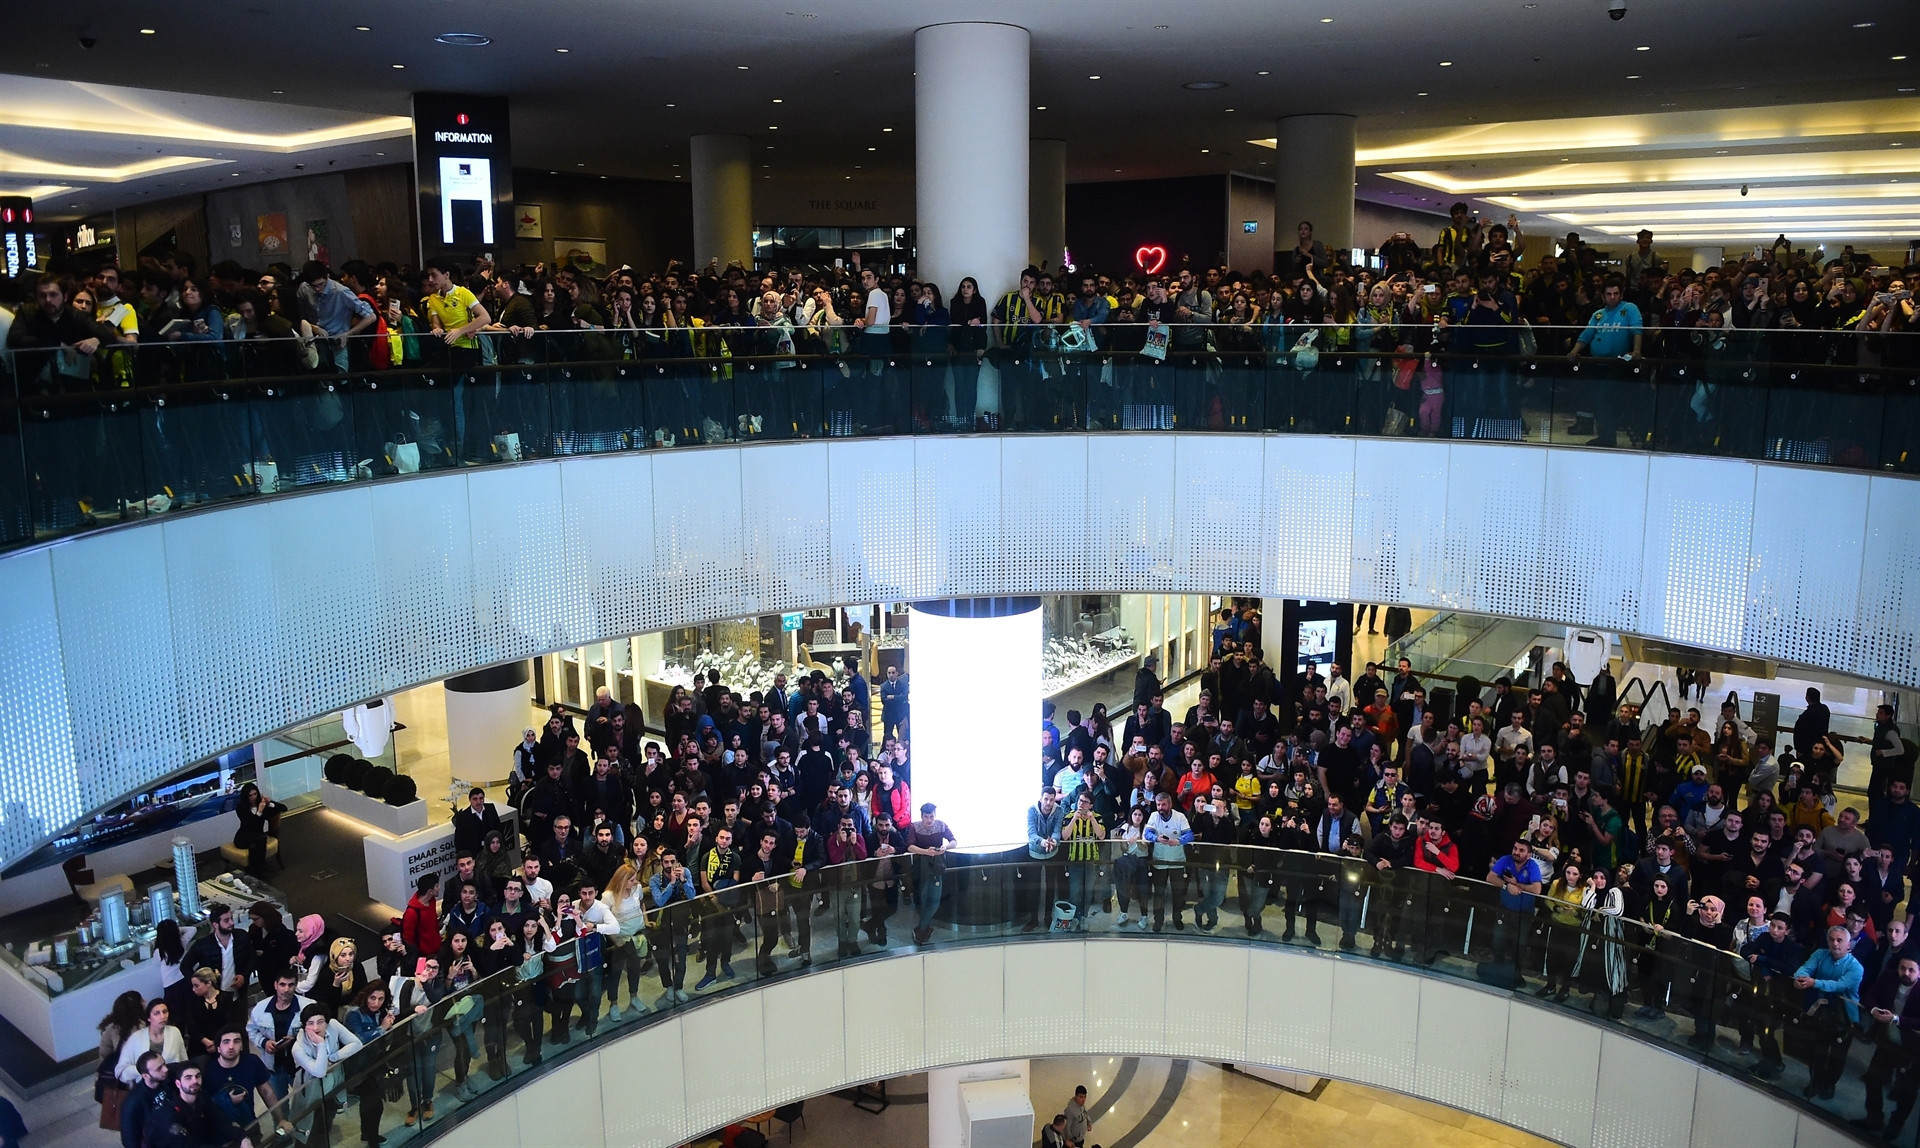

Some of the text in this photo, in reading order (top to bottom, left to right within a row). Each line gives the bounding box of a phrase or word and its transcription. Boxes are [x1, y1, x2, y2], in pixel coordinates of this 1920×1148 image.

[434, 131, 493, 143] INFORMATION
[808, 199, 879, 212] THE SQUARE
[1755, 695, 1766, 703] L2
[53, 836, 78, 848] The
[408, 847, 437, 865] EMAAR
[409, 851, 458, 875] RESIDENCE
